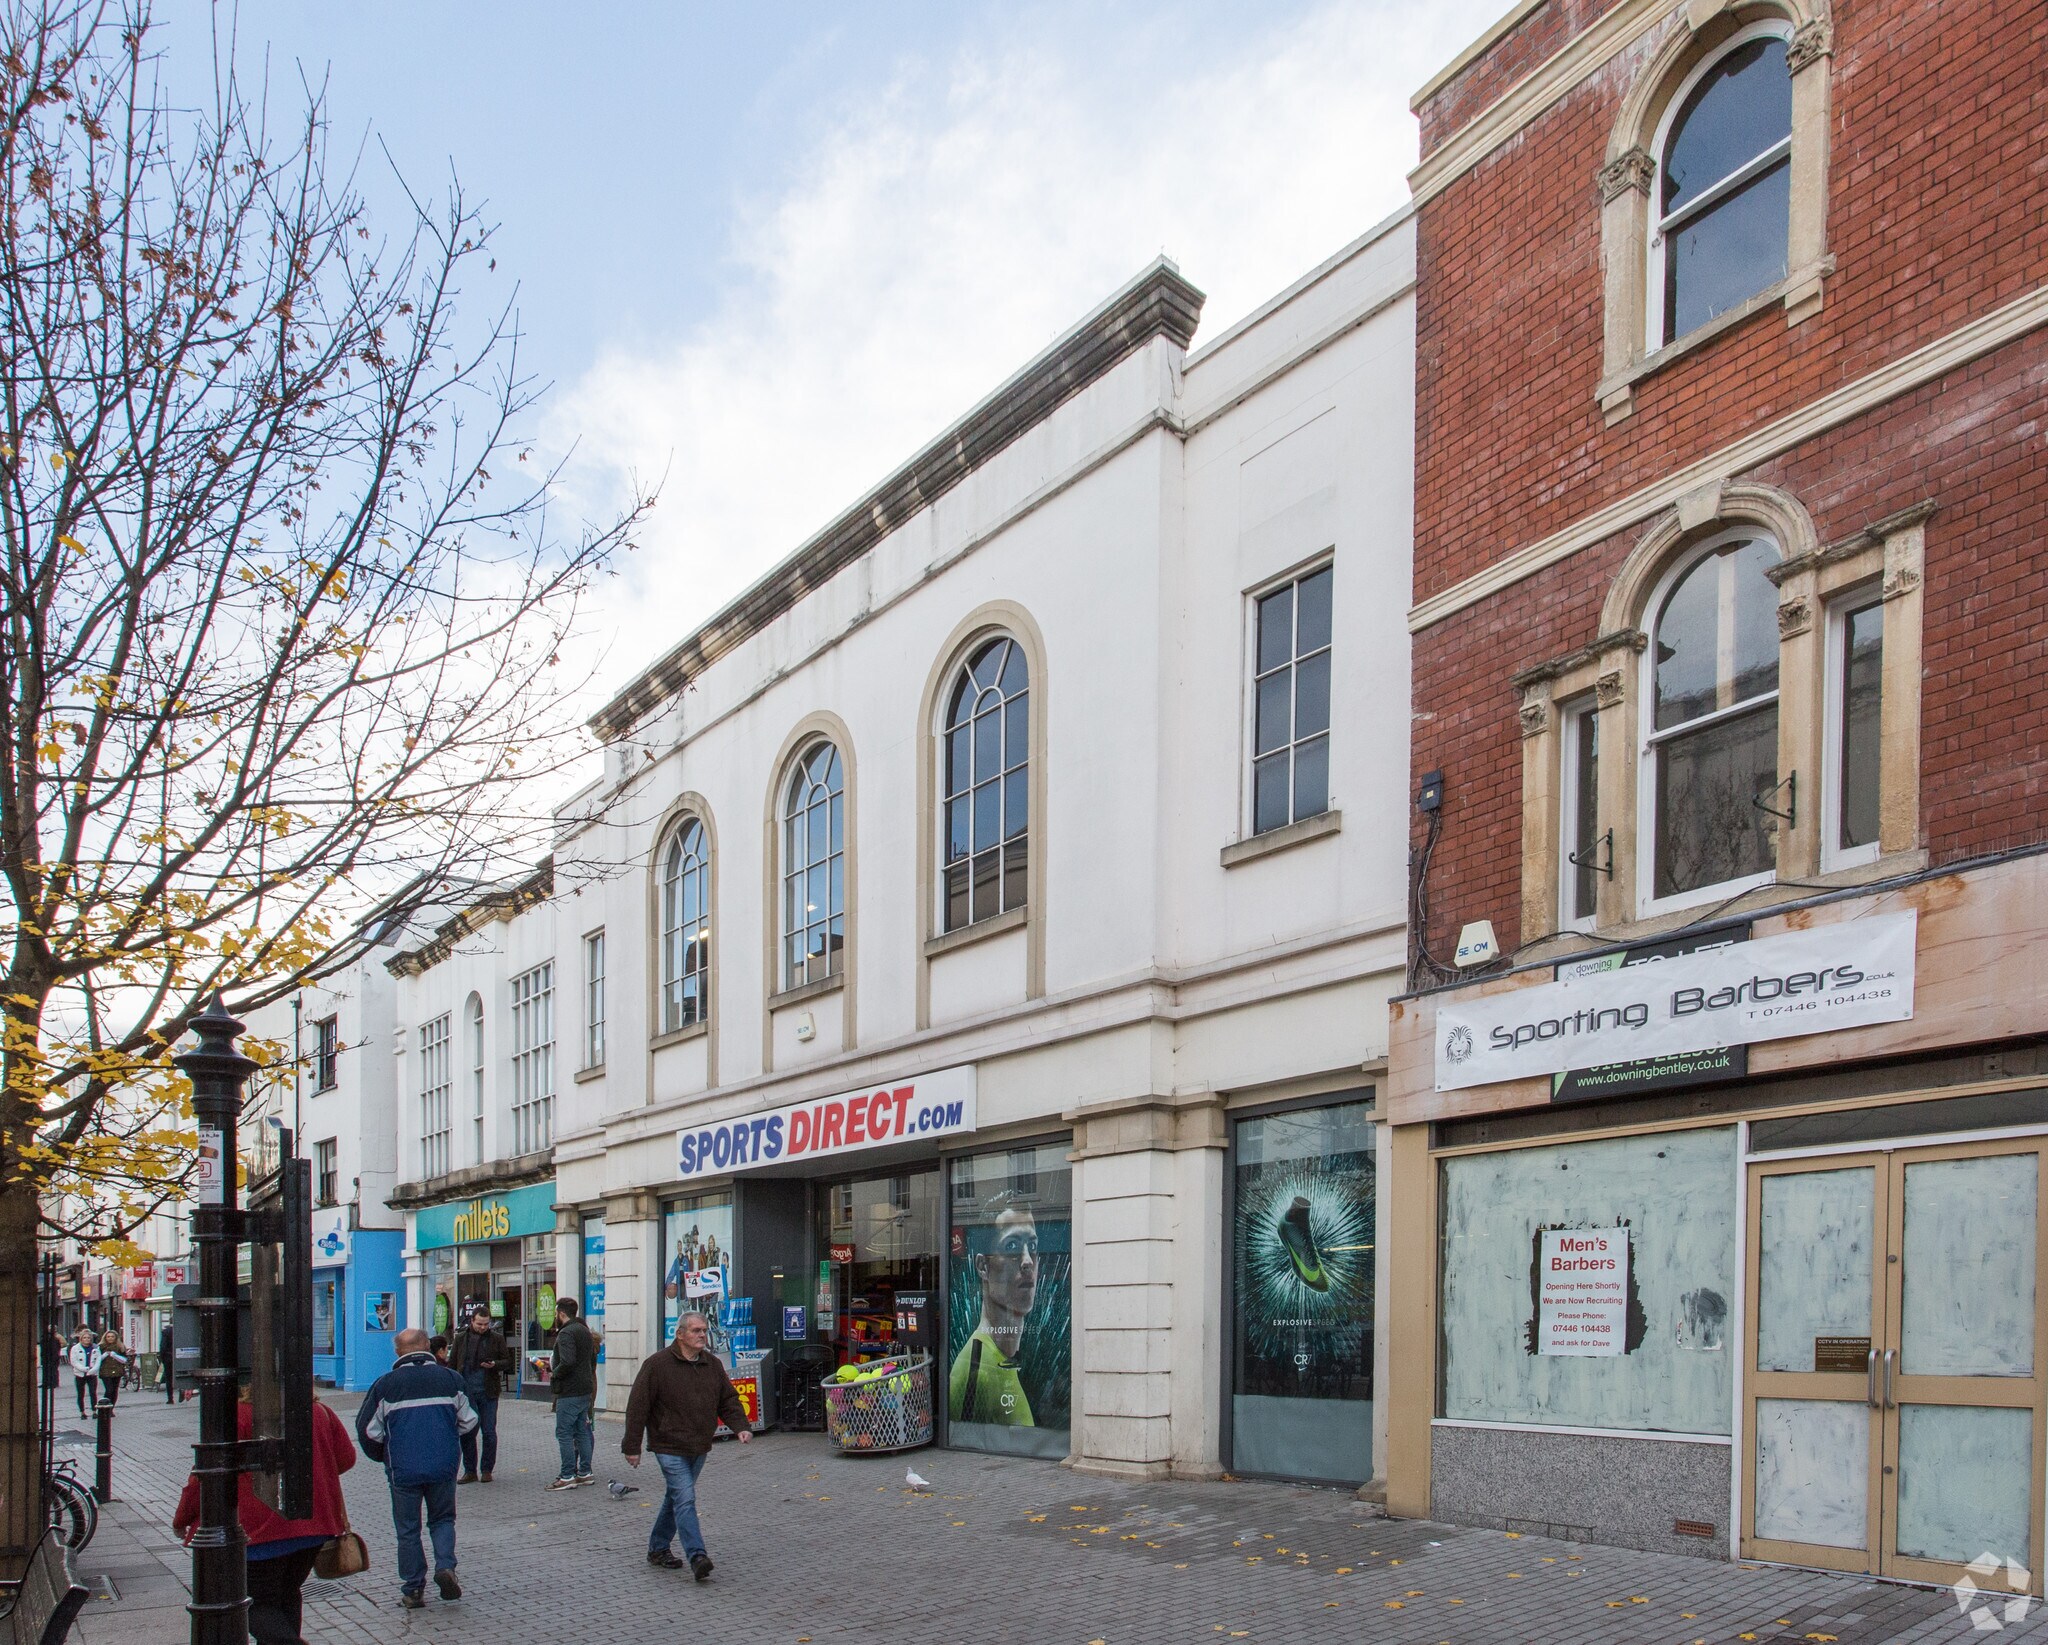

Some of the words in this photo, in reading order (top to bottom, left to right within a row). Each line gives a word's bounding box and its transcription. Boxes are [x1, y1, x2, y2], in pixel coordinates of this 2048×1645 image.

[1575, 958, 1612, 974] downing
[1746, 1011, 1758, 1019] T
[1763, 1001, 1818, 1017] 07446
[1824, 989, 1892, 1006] 104438
[1489, 1003, 1649, 1052] Sporting
[1577, 1055, 1730, 1088] www.downingbentley.co.uk
[453, 1200, 510, 1243] millets
[1560, 1237, 1607, 1252] Men's
[1551, 1257, 1616, 1271] Barbers
[1545, 1283, 1575, 1291] Opening
[1576, 1282, 1594, 1290] Here
[1595, 1282, 1621, 1291] Shortly
[900, 1297, 927, 1305] DUNLOP
[1542, 1297, 1554, 1305] We
[1568, 1297, 1585, 1305] Now
[1586, 1296, 1623, 1306] Recruiting
[1552, 1324, 1578, 1332] 07446
[1580, 1324, 1611, 1333] 104438
[1580, 1339, 1591, 1347] for
[1592, 1339, 1611, 1347] Dave
[1293, 1353, 1313, 1365] CR7
[1000, 1394, 1019, 1407] CR7
